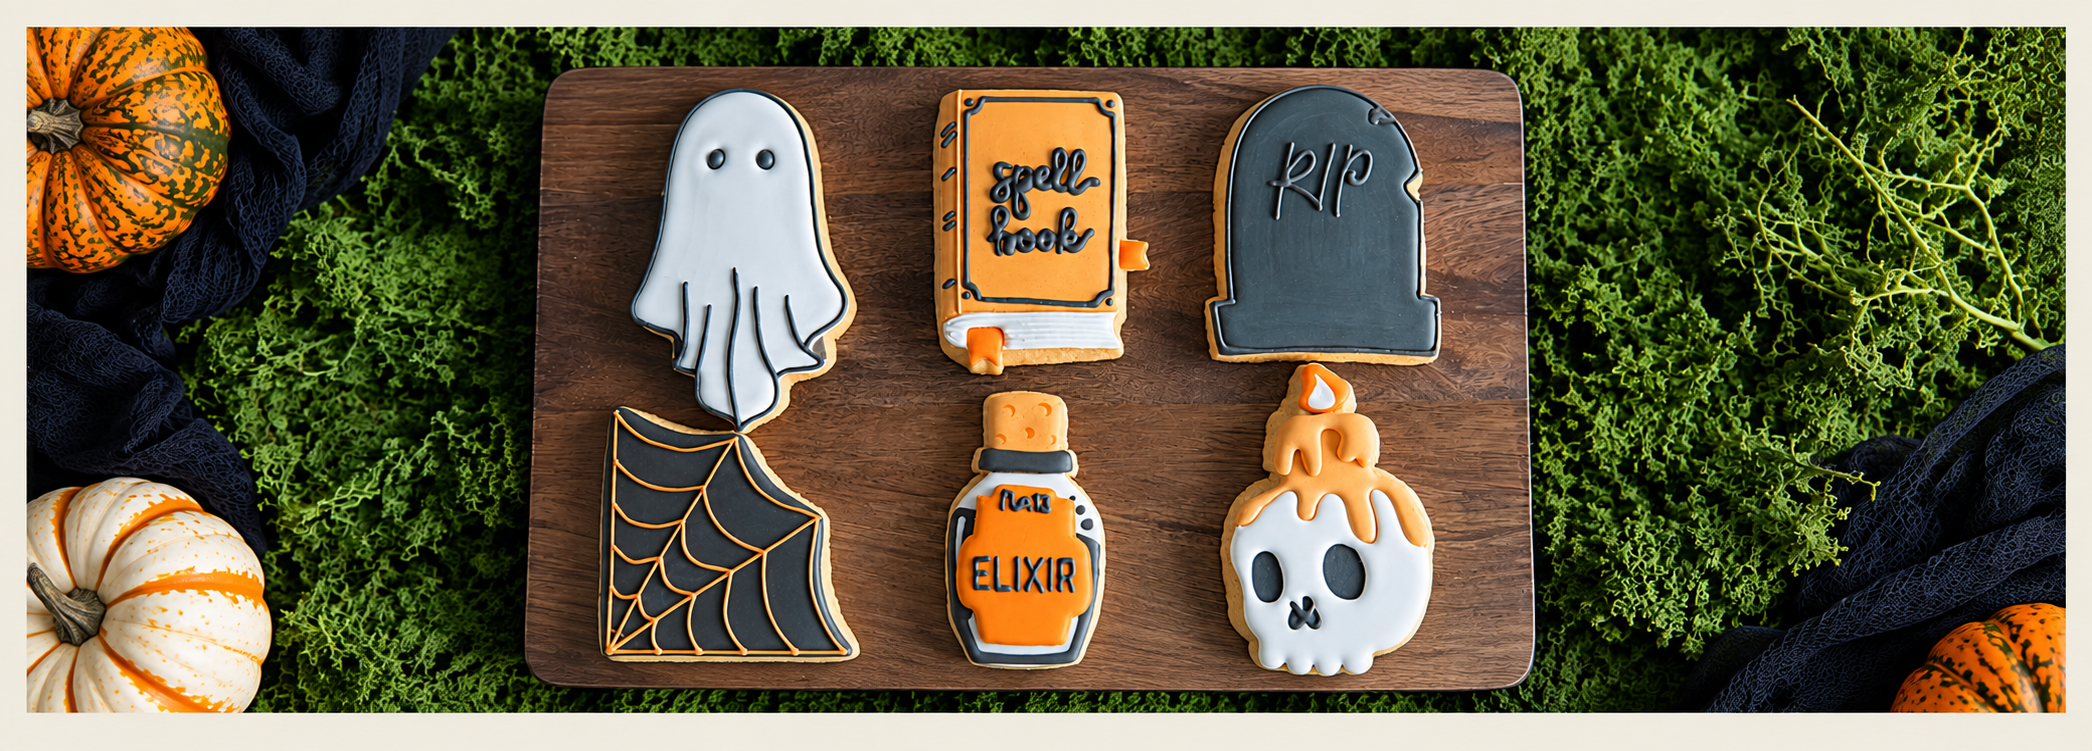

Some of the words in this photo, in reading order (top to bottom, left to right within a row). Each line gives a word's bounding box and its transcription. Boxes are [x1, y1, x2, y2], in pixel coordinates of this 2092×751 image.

[990, 147, 1100, 220] spell
[1269, 142, 1374, 219] RIP
[972, 556, 1075, 594] ELIXIR
